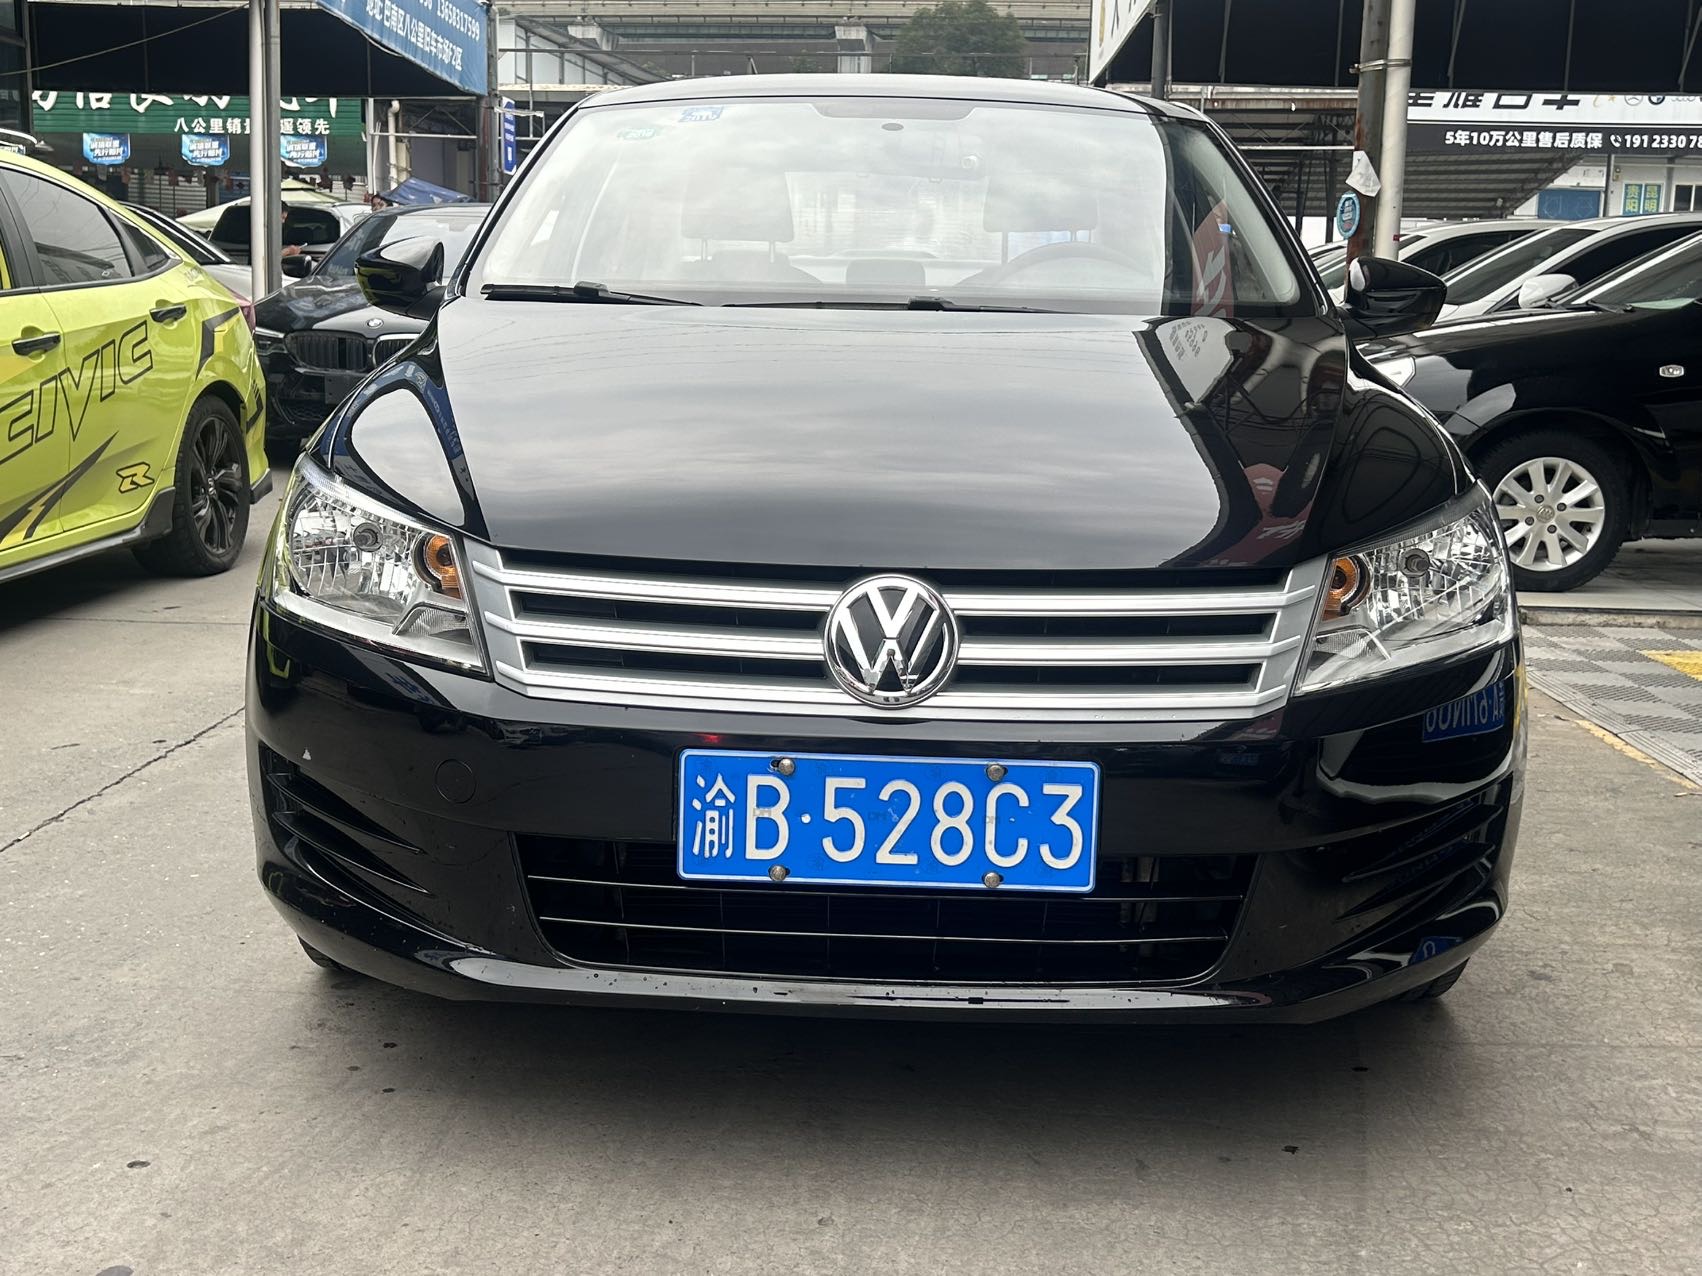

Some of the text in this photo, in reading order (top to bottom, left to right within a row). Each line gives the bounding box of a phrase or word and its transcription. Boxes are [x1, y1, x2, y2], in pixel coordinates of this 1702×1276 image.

[1445, 130, 1603, 149] 5年10万公里售后质保
[1624, 134, 1649, 148] 191
[1651, 134, 1687, 149] 2330
[0, 320, 153, 464] CIVIC
[692, 773, 1084, 870] 渝B·528C3
